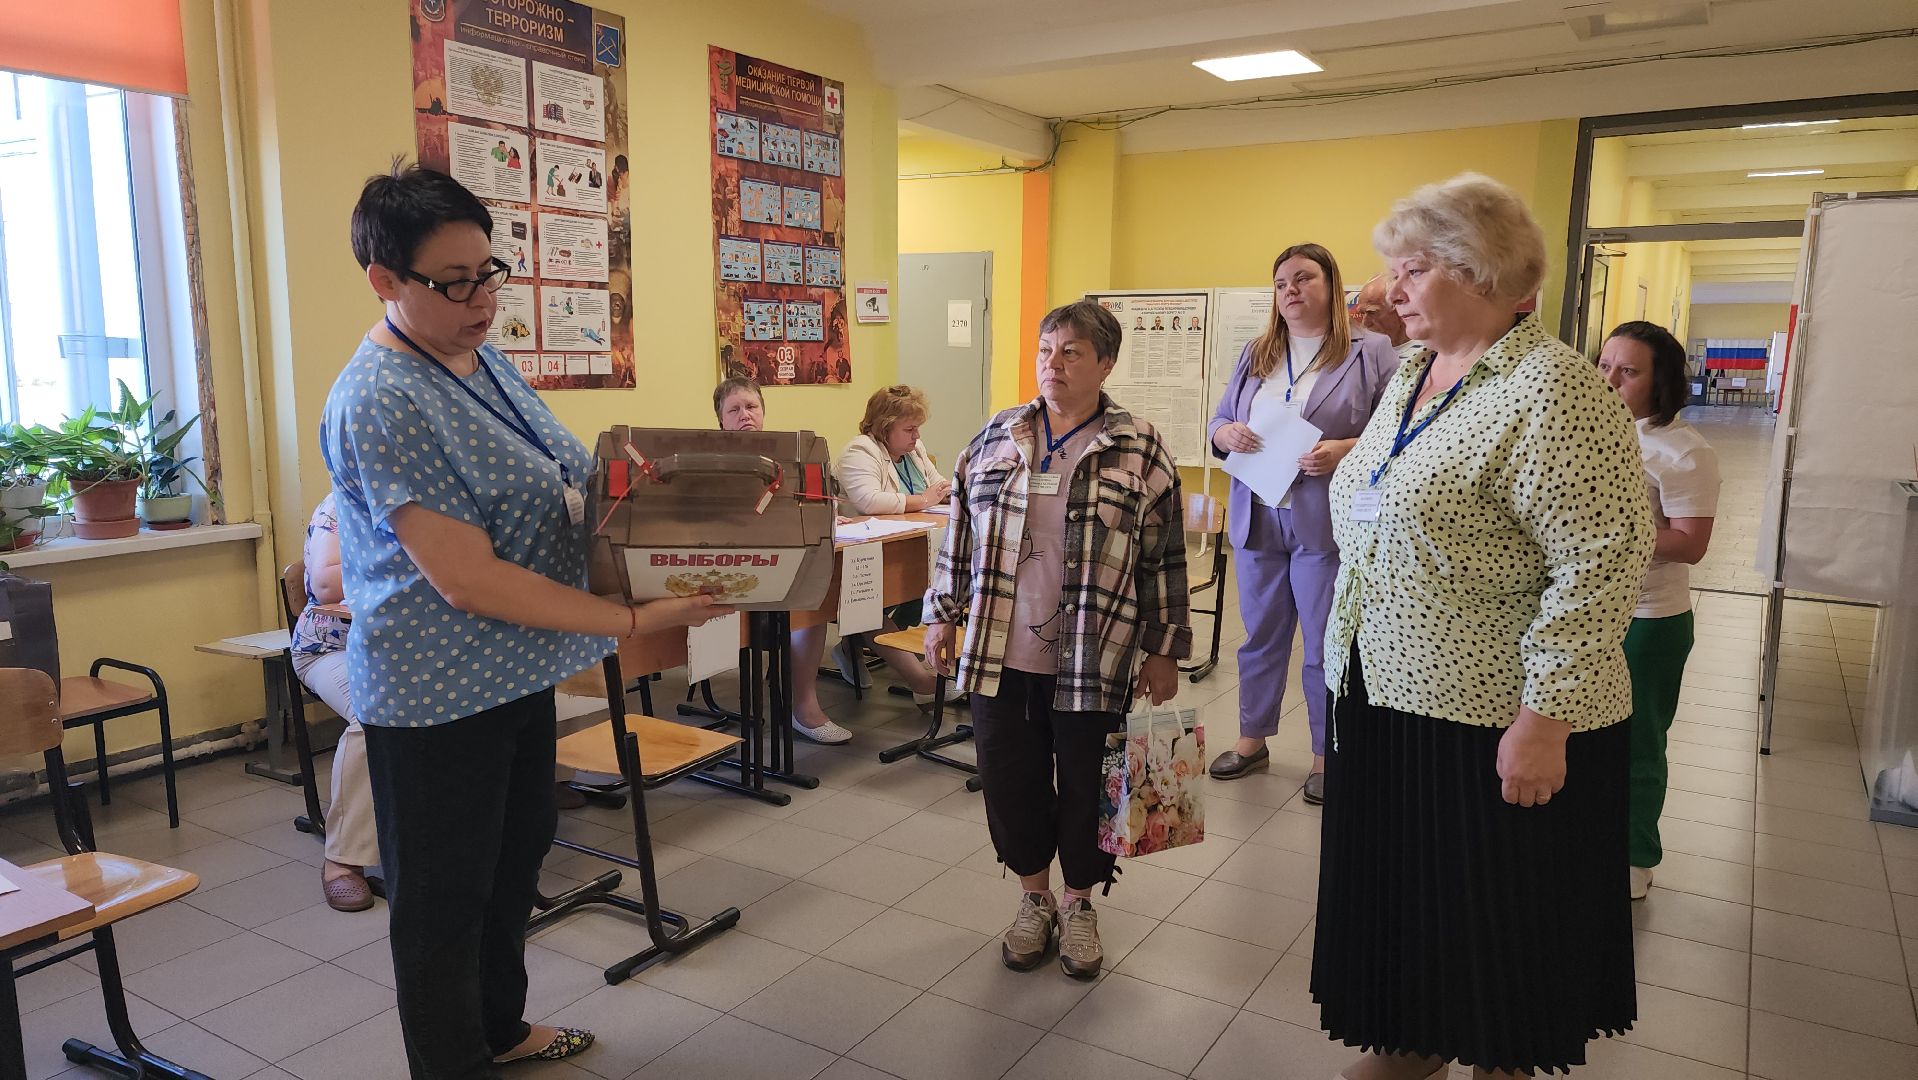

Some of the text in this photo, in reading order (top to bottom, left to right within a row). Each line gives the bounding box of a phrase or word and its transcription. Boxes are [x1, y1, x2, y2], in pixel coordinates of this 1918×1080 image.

[485, 8, 564, 43] ТЕРРОРИЗМ
[747, 64, 815, 92] ОКАЗАНИЕ ПЕРВОЙ
[735, 75, 790, 99] МЕДИЦИНСКОЙ
[791, 89, 822, 107] ПОМОЩИ
[521, 360, 559, 372] 03 04
[778, 347, 794, 363] 03
[649, 553, 779, 567] ВЫБОРЫ
